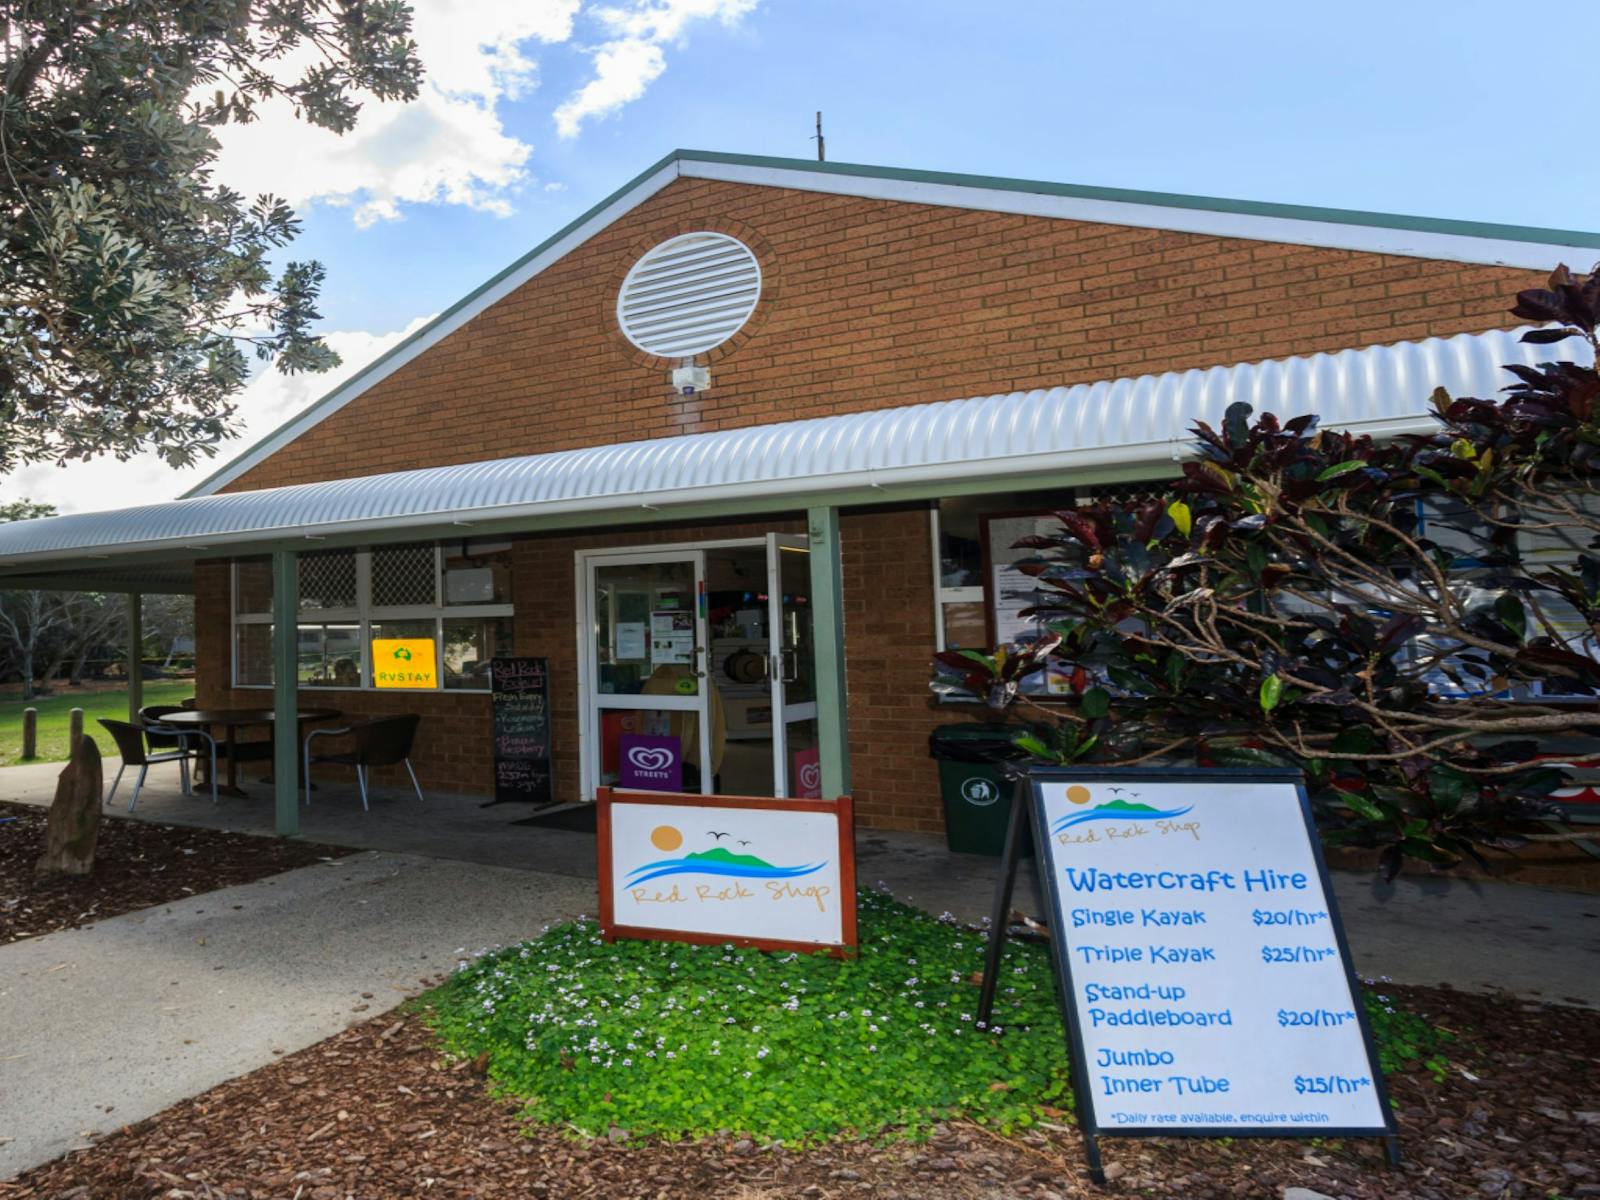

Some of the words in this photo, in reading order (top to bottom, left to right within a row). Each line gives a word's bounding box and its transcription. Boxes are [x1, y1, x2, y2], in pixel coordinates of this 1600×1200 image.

[634, 770, 669, 779] STREETS
[1058, 829, 1098, 846] Red
[1105, 824, 1149, 840] Rock
[1155, 820, 1201, 841] Shop
[1243, 868, 1307, 892] Hire
[631, 885, 687, 905] Red
[696, 881, 755, 902] Rock
[765, 881, 831, 913] Shop
[1071, 908, 1134, 928] Single
[1141, 908, 1207, 927] Kayak
[1076, 945, 1143, 963] Triple
[1149, 945, 1216, 963] Kayak
[1084, 983, 1186, 1003] Stand-up
[1088, 1007, 1233, 1027] Paddleboard
[1096, 1048, 1174, 1068] Jumbo
[1101, 1075, 1162, 1096] Inner
[1168, 1075, 1230, 1096] Tube
[1151, 1114, 1177, 1123] rate
[1240, 1113, 1287, 1124] enquire
[1291, 1113, 1329, 1123] within
